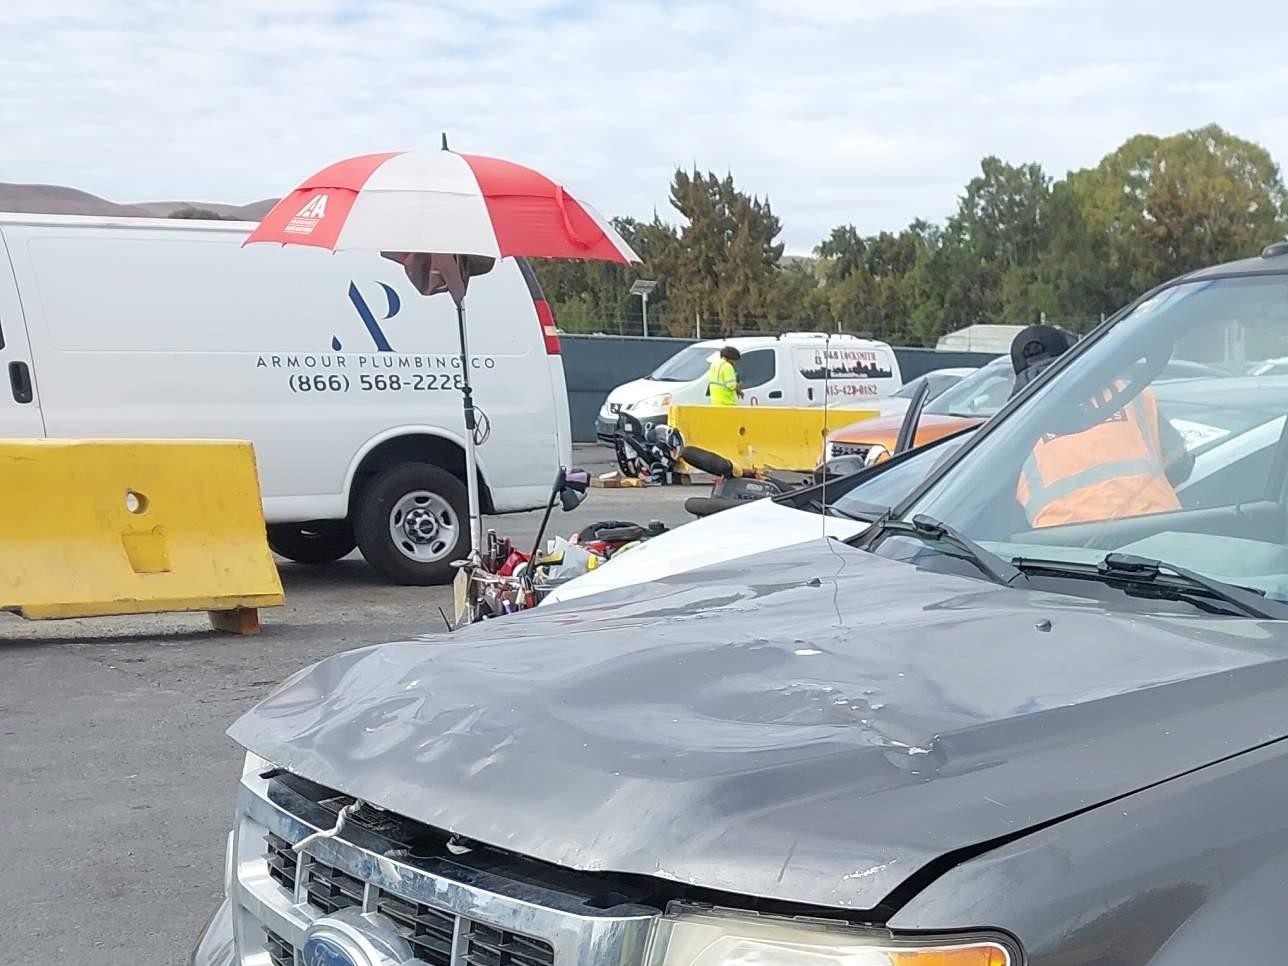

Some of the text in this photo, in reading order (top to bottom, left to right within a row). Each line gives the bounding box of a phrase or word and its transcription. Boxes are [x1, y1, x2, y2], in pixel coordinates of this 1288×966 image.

[256, 355, 496, 369] ARMOUR PLUMBING CO
[289, 373, 463, 393] (866) 568-2228
